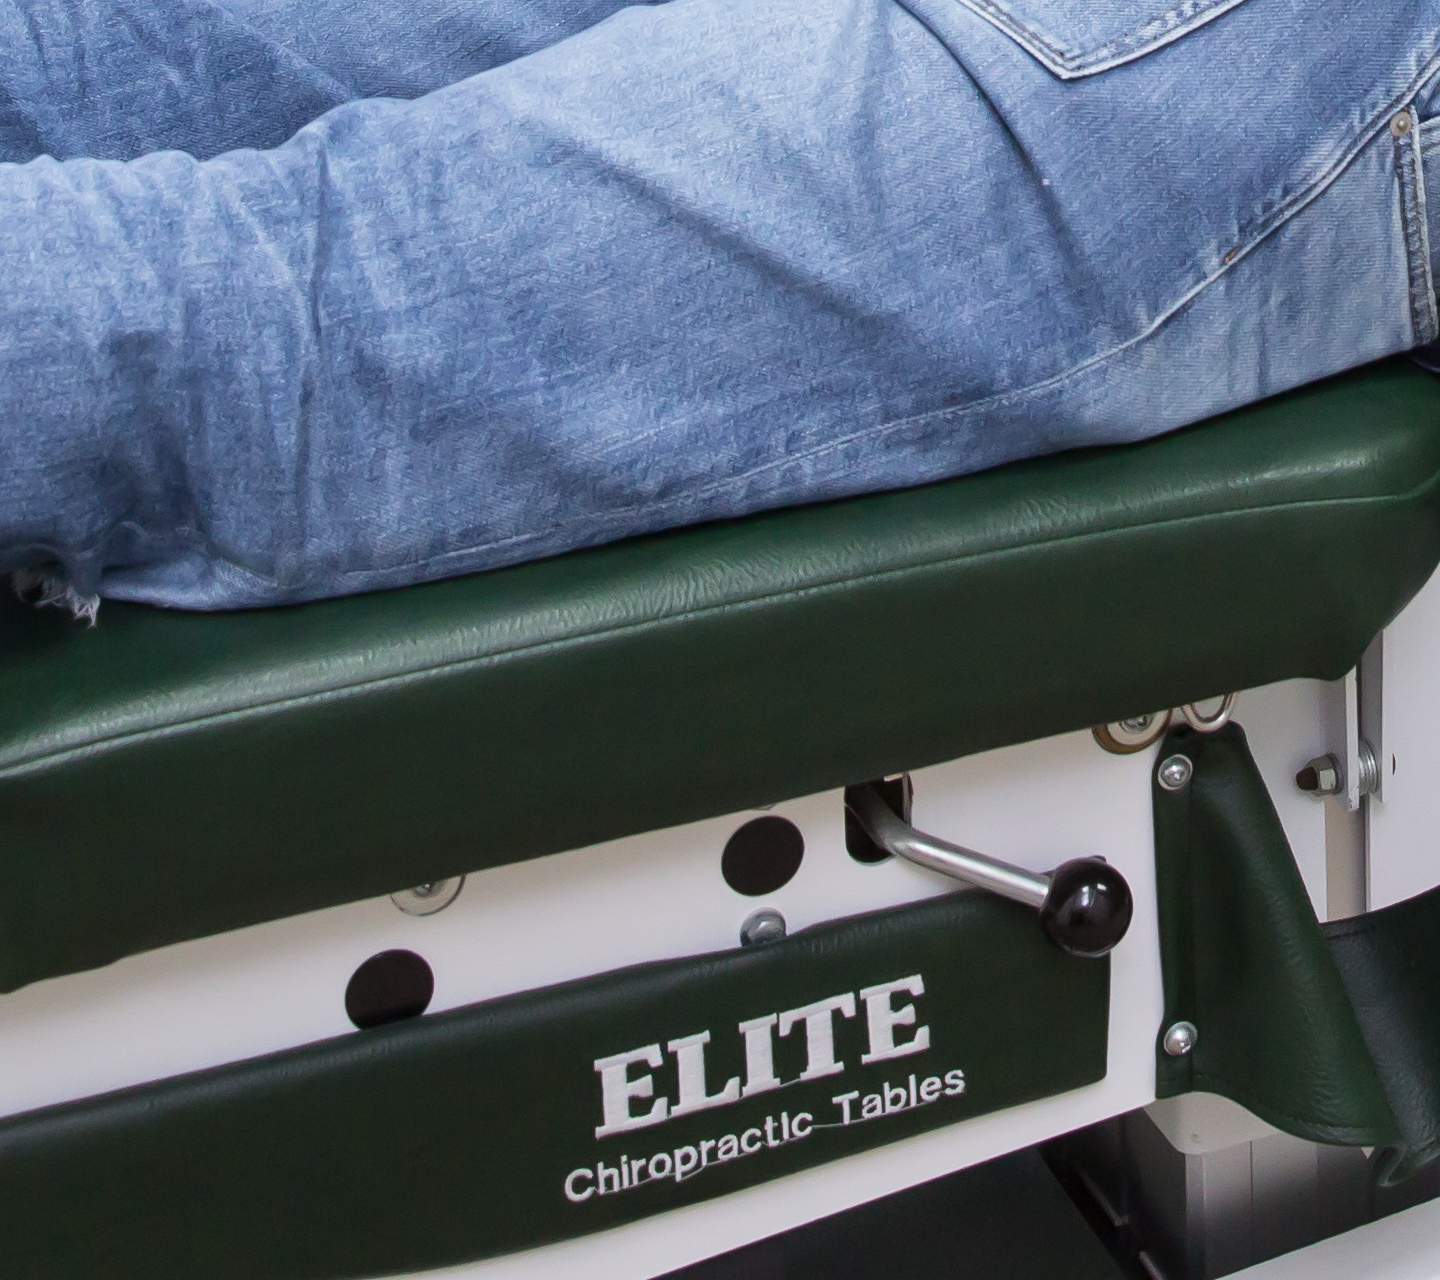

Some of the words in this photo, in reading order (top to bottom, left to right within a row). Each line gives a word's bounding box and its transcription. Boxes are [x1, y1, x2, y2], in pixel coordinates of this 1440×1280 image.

[594, 974, 931, 1140] ELITE
[564, 1109, 814, 1203] Chiropractic
[832, 1068, 966, 1126] Tables
